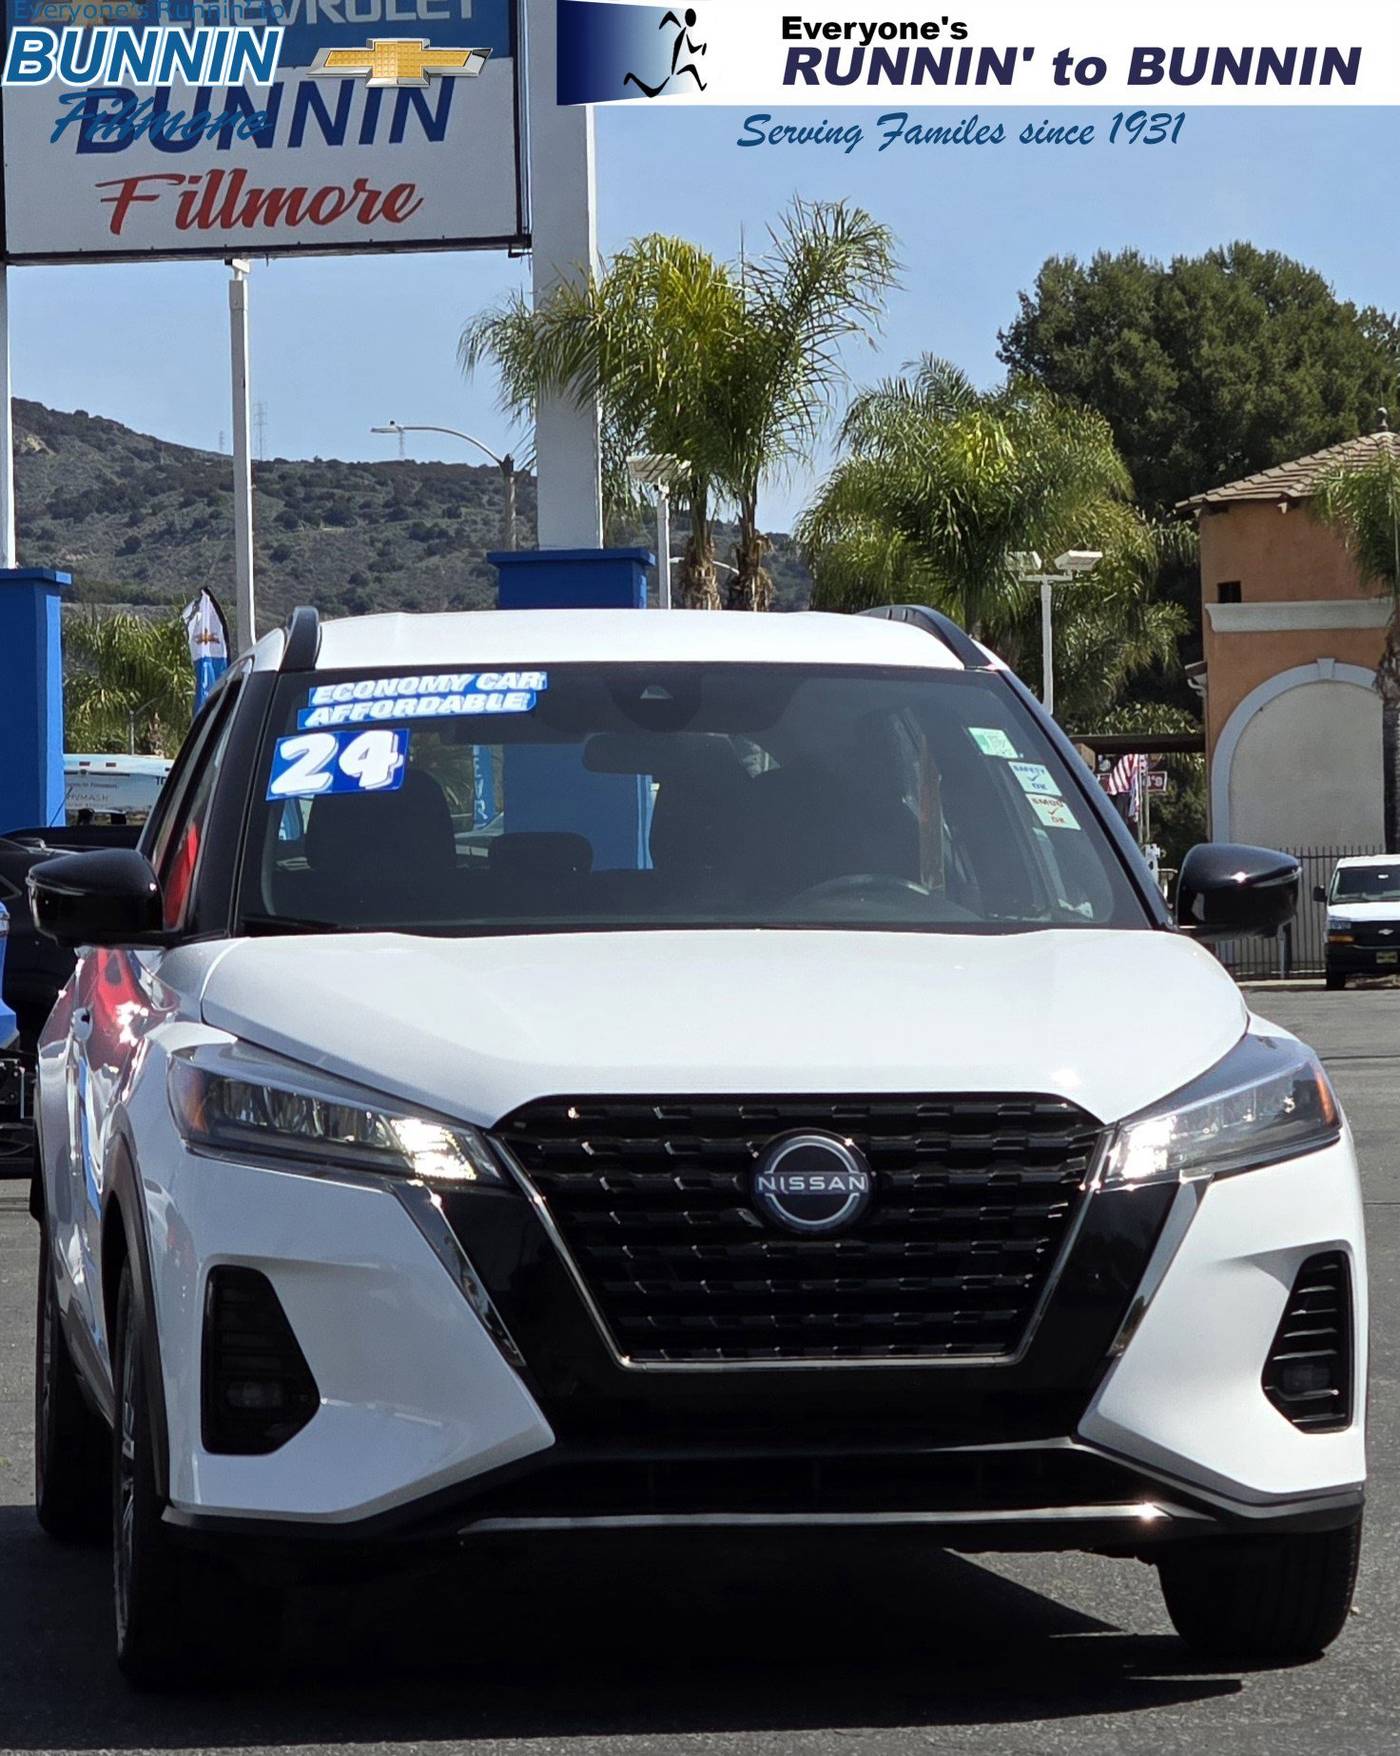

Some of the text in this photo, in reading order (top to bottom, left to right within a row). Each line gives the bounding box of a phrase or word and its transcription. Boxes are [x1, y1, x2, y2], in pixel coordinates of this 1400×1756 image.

[76, 76, 455, 155] BUNNIN
[95, 168, 424, 236] Fillmore
[304, 691, 533, 726] AFFORDABLE
[311, 671, 545, 704] ECONOMY CAR
[270, 730, 405, 796] 24
[758, 1176, 865, 1191] NISSAN
